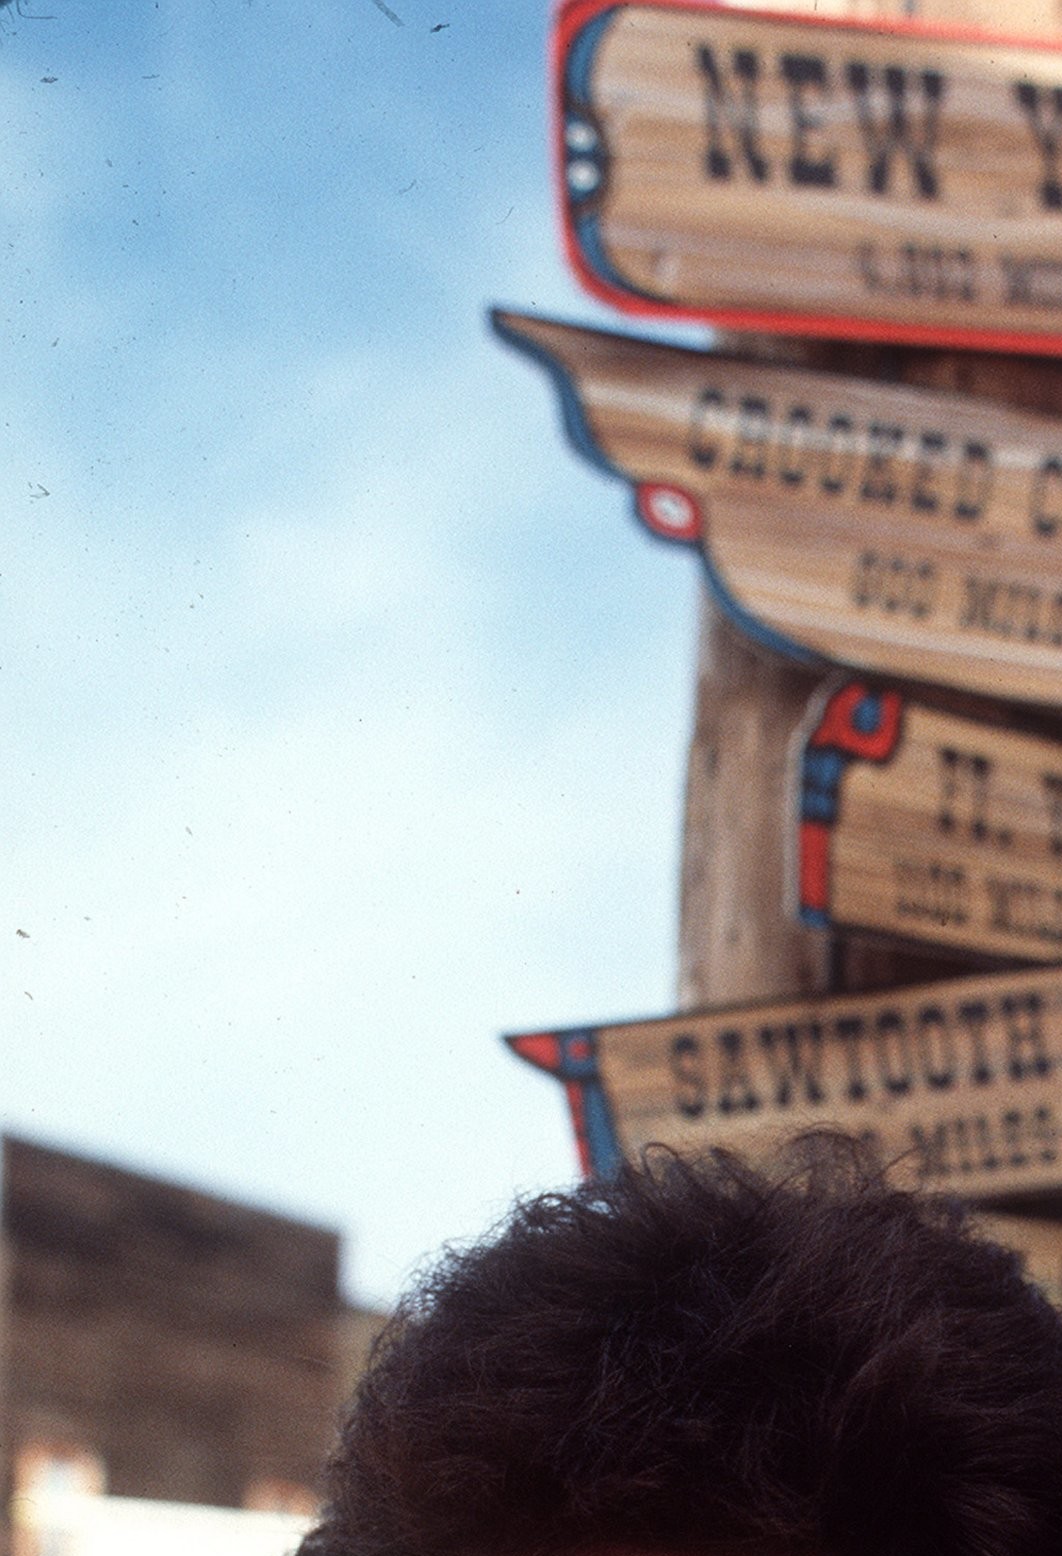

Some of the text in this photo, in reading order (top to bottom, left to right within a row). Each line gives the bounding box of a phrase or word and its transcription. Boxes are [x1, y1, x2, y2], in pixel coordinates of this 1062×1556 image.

[696, 43, 945, 200] NEW
[687, 387, 999, 522] CROOKED
[669, 992, 1054, 1120] SAWTOOTH
[908, 1103, 1058, 1179] MILES
